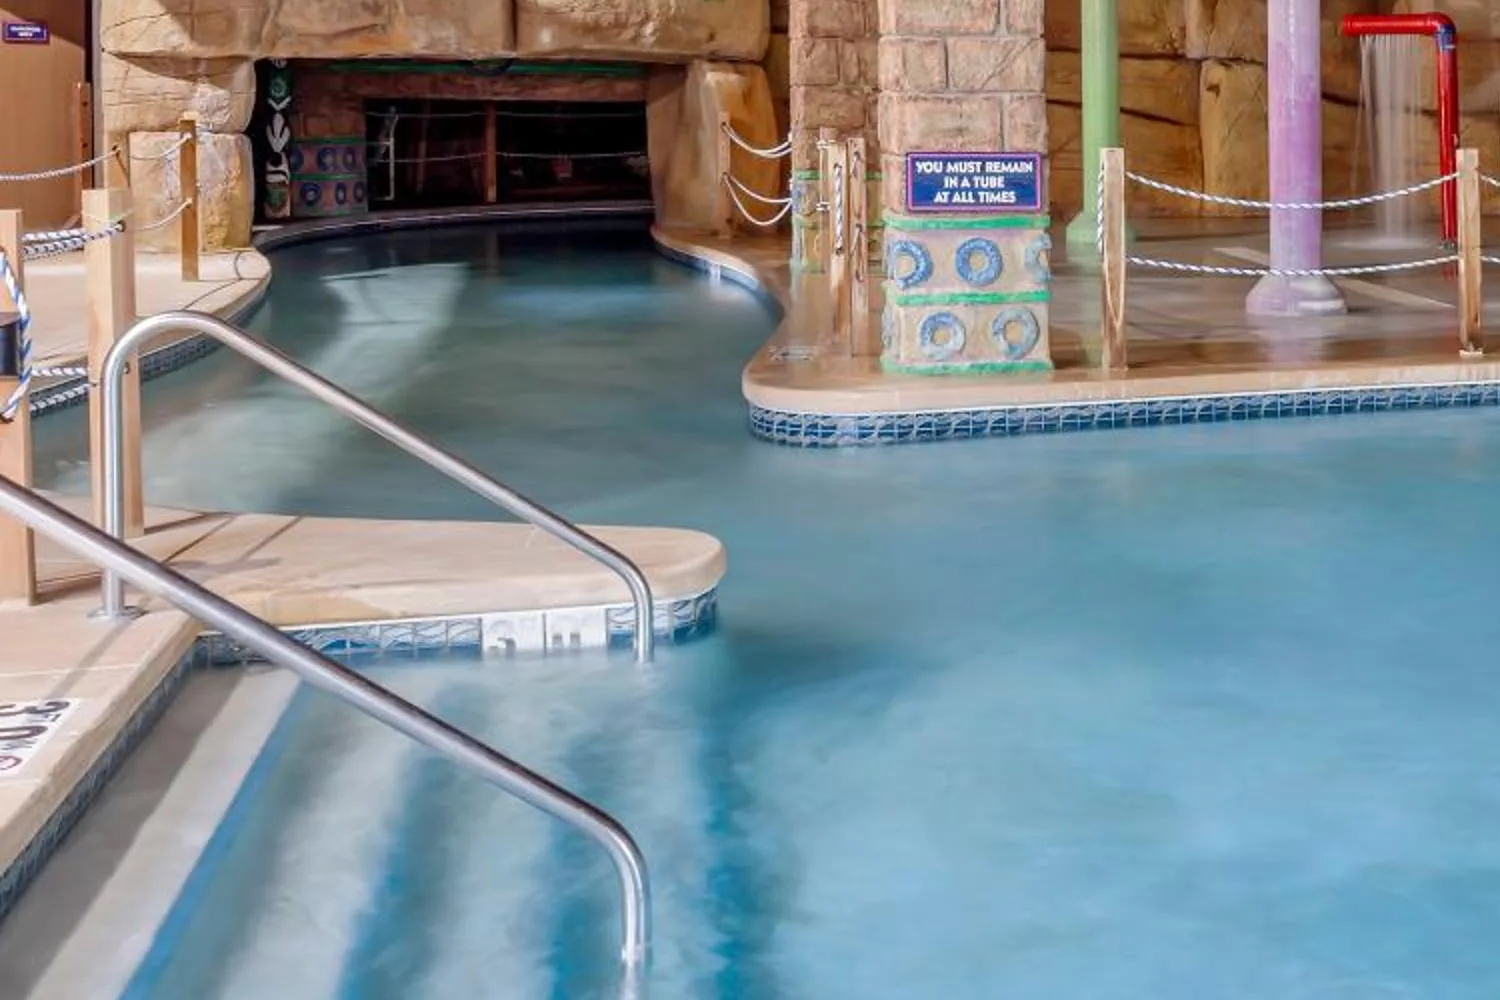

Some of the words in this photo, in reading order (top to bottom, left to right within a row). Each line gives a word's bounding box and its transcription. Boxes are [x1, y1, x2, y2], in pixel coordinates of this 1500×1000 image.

[916, 161, 942, 173] YOU
[946, 161, 982, 173] MUST
[985, 161, 1033, 173] REMAIN
[944, 176, 958, 188] IN
[961, 176, 971, 188] A
[974, 176, 1005, 188] TUBE
[933, 191, 949, 204] AT
[953, 191, 975, 204] ALL
[978, 191, 1017, 204] TIMES
